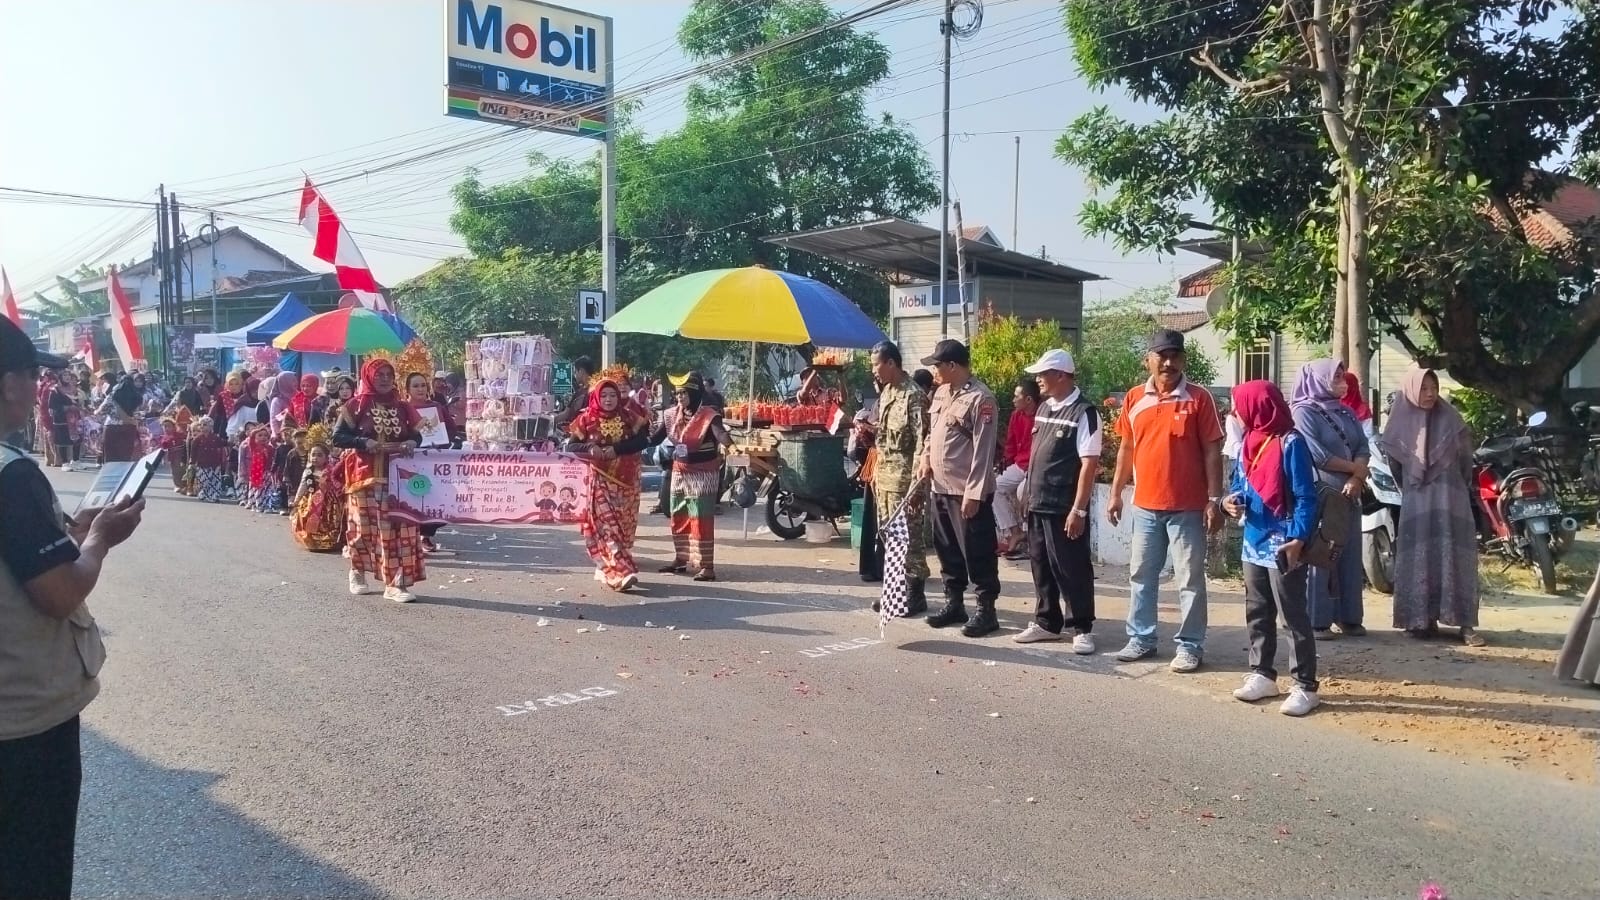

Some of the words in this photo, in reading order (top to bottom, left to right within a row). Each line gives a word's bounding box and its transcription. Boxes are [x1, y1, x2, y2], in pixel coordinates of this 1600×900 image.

[458, 0, 596, 73] Mobil
[898, 294, 927, 309] Mobil
[459, 453, 527, 463] KARNAVAL
[433, 463, 451, 476] KB
[456, 464, 494, 477] TUNAS
[497, 464, 551, 478] HARAPAN
[413, 479, 425, 489] 03
[455, 493, 474, 503] HUT
[483, 493, 493, 503] RI
[506, 494, 515, 503] 81
[457, 503, 477, 513] Cinta
[481, 504, 502, 513] Tanah
[505, 503, 518, 513] Air
